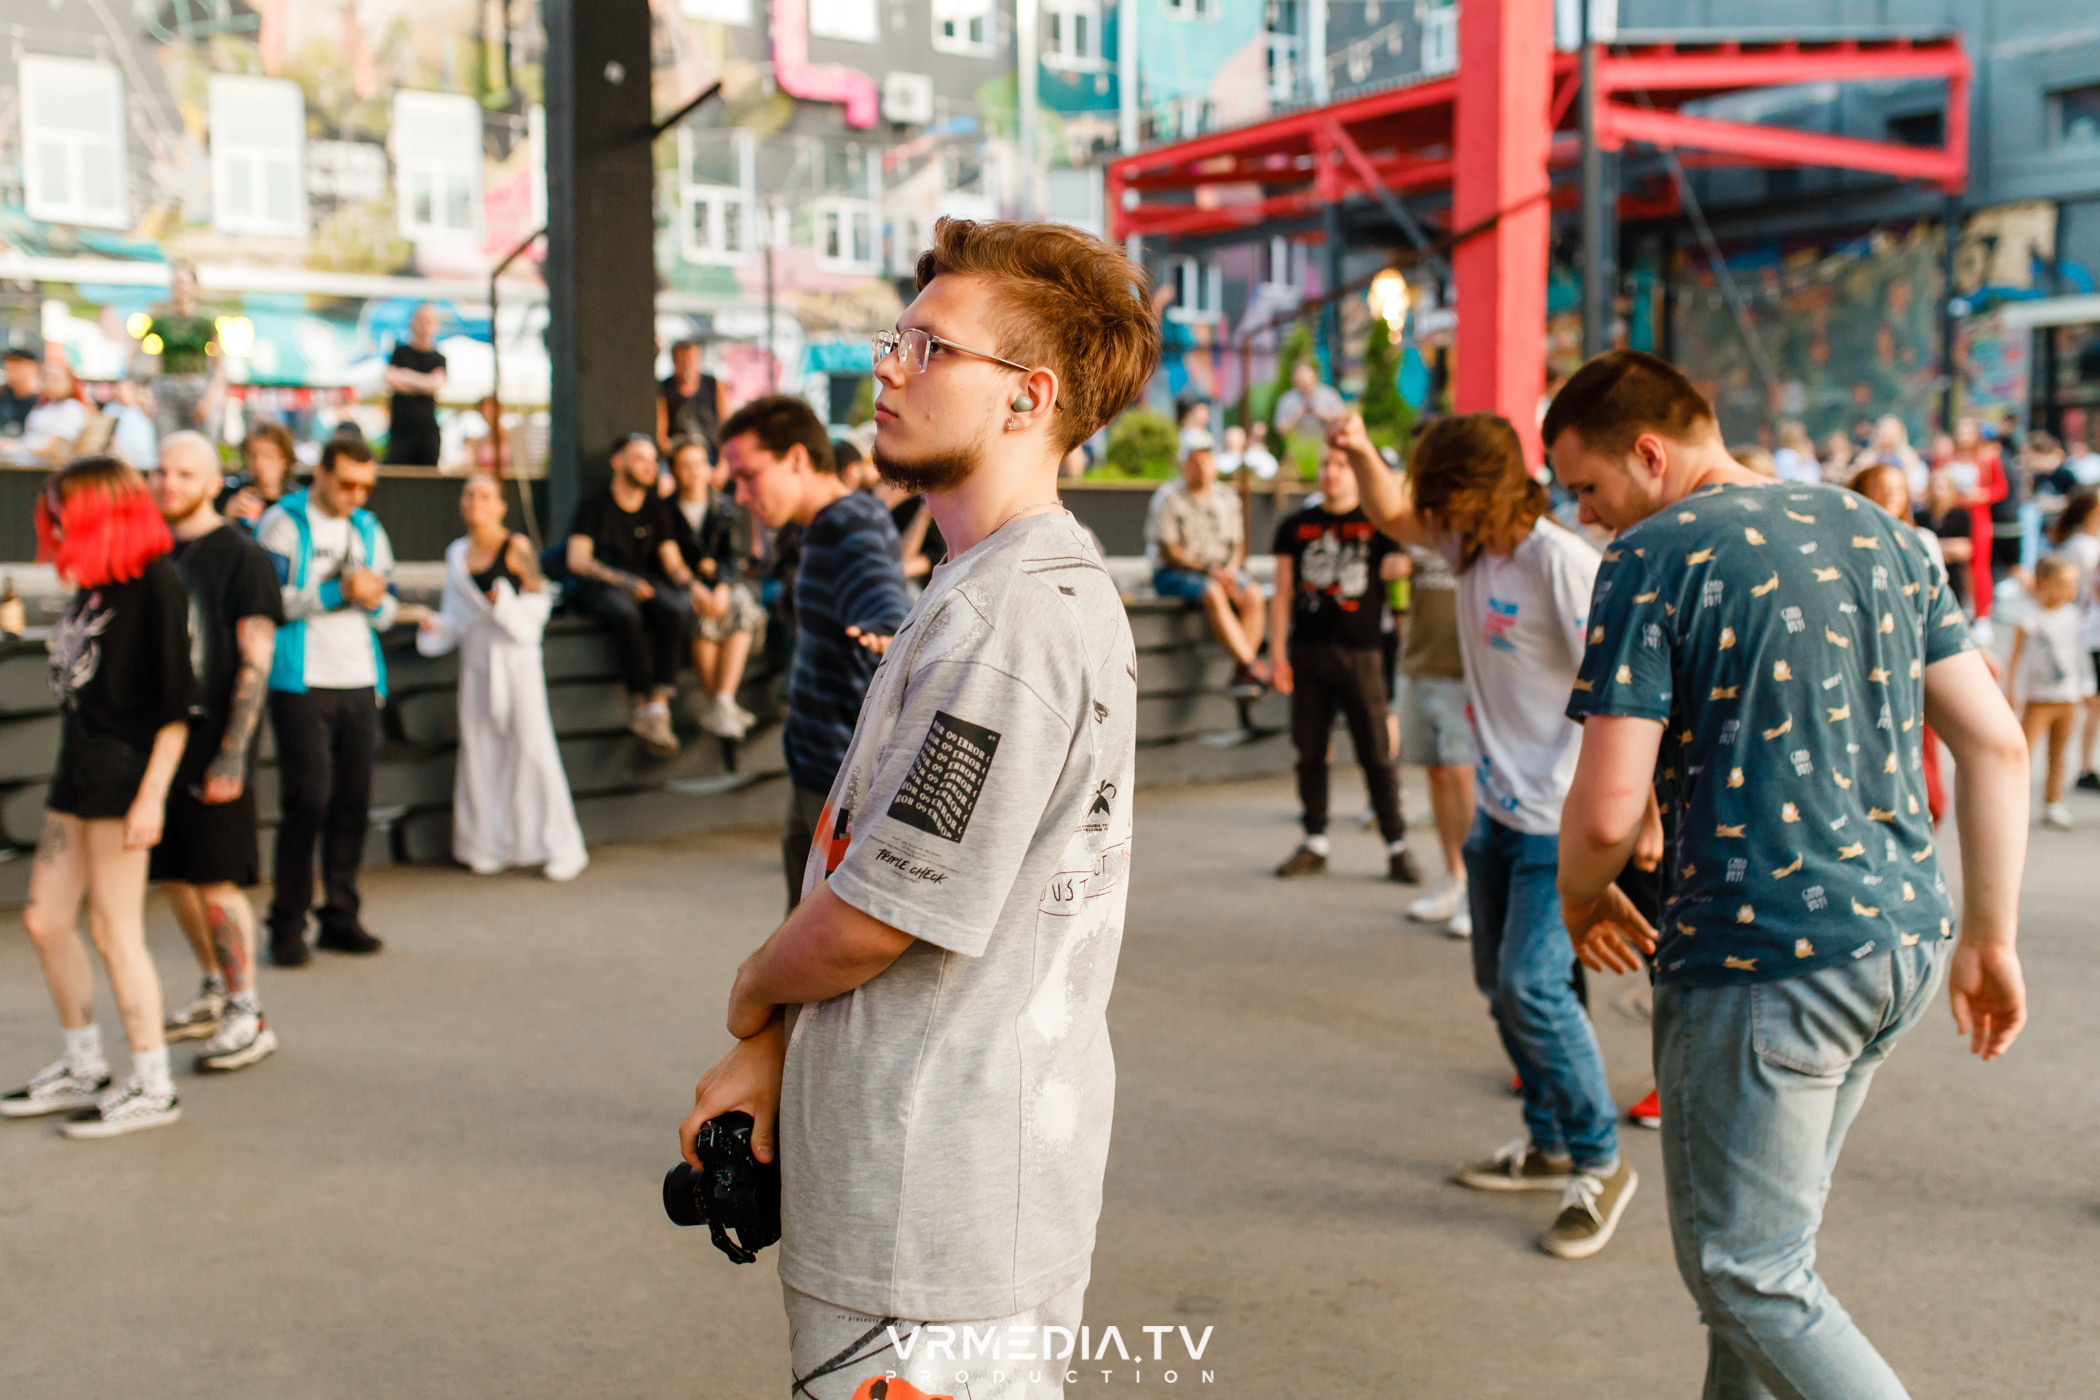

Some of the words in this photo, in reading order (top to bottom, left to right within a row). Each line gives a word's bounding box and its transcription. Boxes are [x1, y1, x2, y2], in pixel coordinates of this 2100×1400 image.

[941, 742, 953, 752] 09
[952, 749, 981, 773] ERROR
[945, 731, 958, 742] 09
[956, 736, 985, 760] ERROR
[931, 763, 944, 773] 09
[943, 772, 973, 794] ERROR
[936, 752, 949, 763] 09
[947, 761, 977, 783] ERROR
[922, 783, 935, 793] 09
[934, 790, 963, 819] ERROR
[927, 774, 939, 783] 09
[939, 781, 968, 806] ERROR
[915, 802, 927, 813] 09
[919, 793, 931, 803] 09
[931, 798, 958, 831] ERROR
[875, 848, 910, 871] TRIPLE
[909, 866, 949, 885] CHECK
